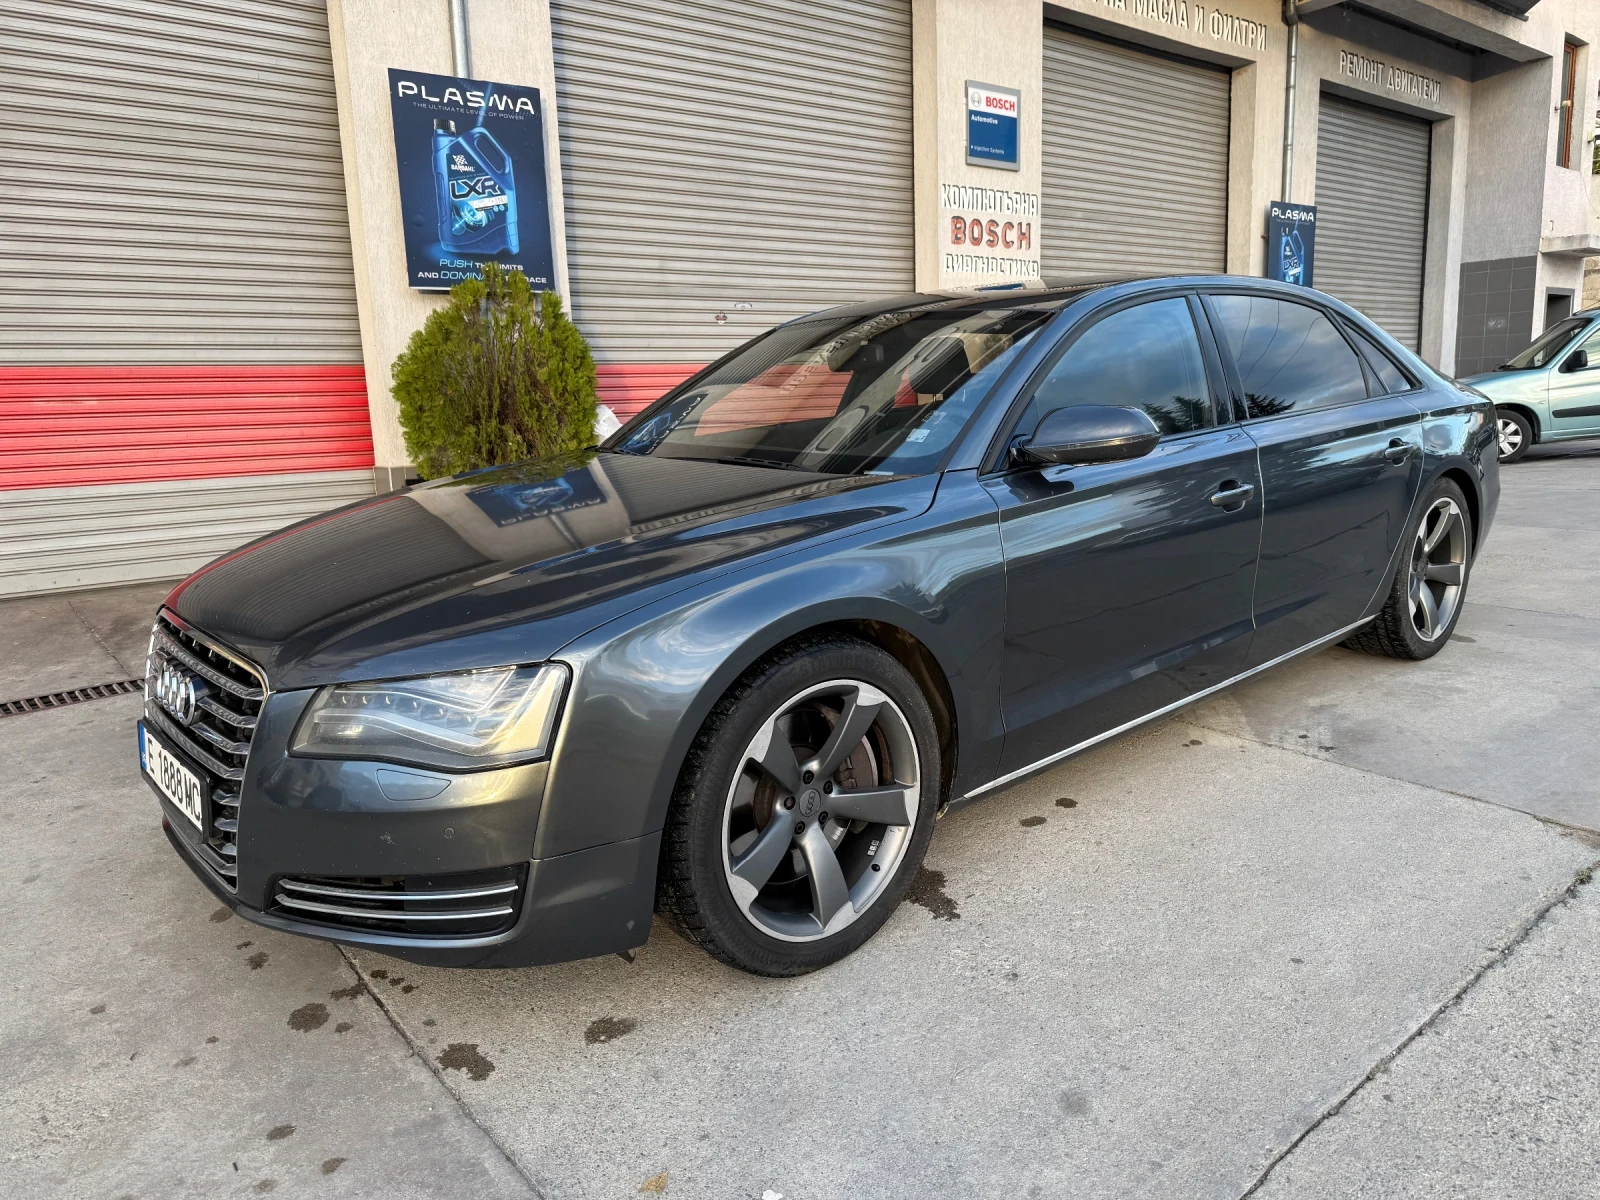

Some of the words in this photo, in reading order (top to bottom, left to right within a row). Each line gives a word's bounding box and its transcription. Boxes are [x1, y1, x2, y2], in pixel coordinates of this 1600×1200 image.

[1195, 5, 1205, 34] И
[1210, 9, 1267, 52] ФИЛТРИ
[1340, 50, 1385, 86] РЕМОНТ
[1387, 66, 1441, 103] ДВИГАТЕЛИ
[397, 81, 535, 115] PLASMA
[985, 96, 1015, 112] BOSCH
[413, 101, 427, 109] THE
[428, 104, 465, 114] ULTIMATE
[466, 109, 487, 117] LEVEL
[498, 113, 525, 121] POWER
[971, 114, 998, 125] Automotive
[974, 144, 990, 152] Injection
[990, 147, 1005, 155] Systems
[449, 176, 501, 200] LXR
[941, 183, 1038, 217] КОМПЮТЪРНА
[1272, 207, 1314, 222] PLASMA
[950, 215, 1031, 250] BOSCH
[418, 271, 439, 279] AND
[440, 259, 472, 268] PUSH
[499, 263, 524, 271] IMITS
[943, 253, 1039, 278] ДИАГНОСТИКА
[148, 739, 156, 775] E
[158, 751, 184, 805] 1888
[184, 772, 202, 822] MC
